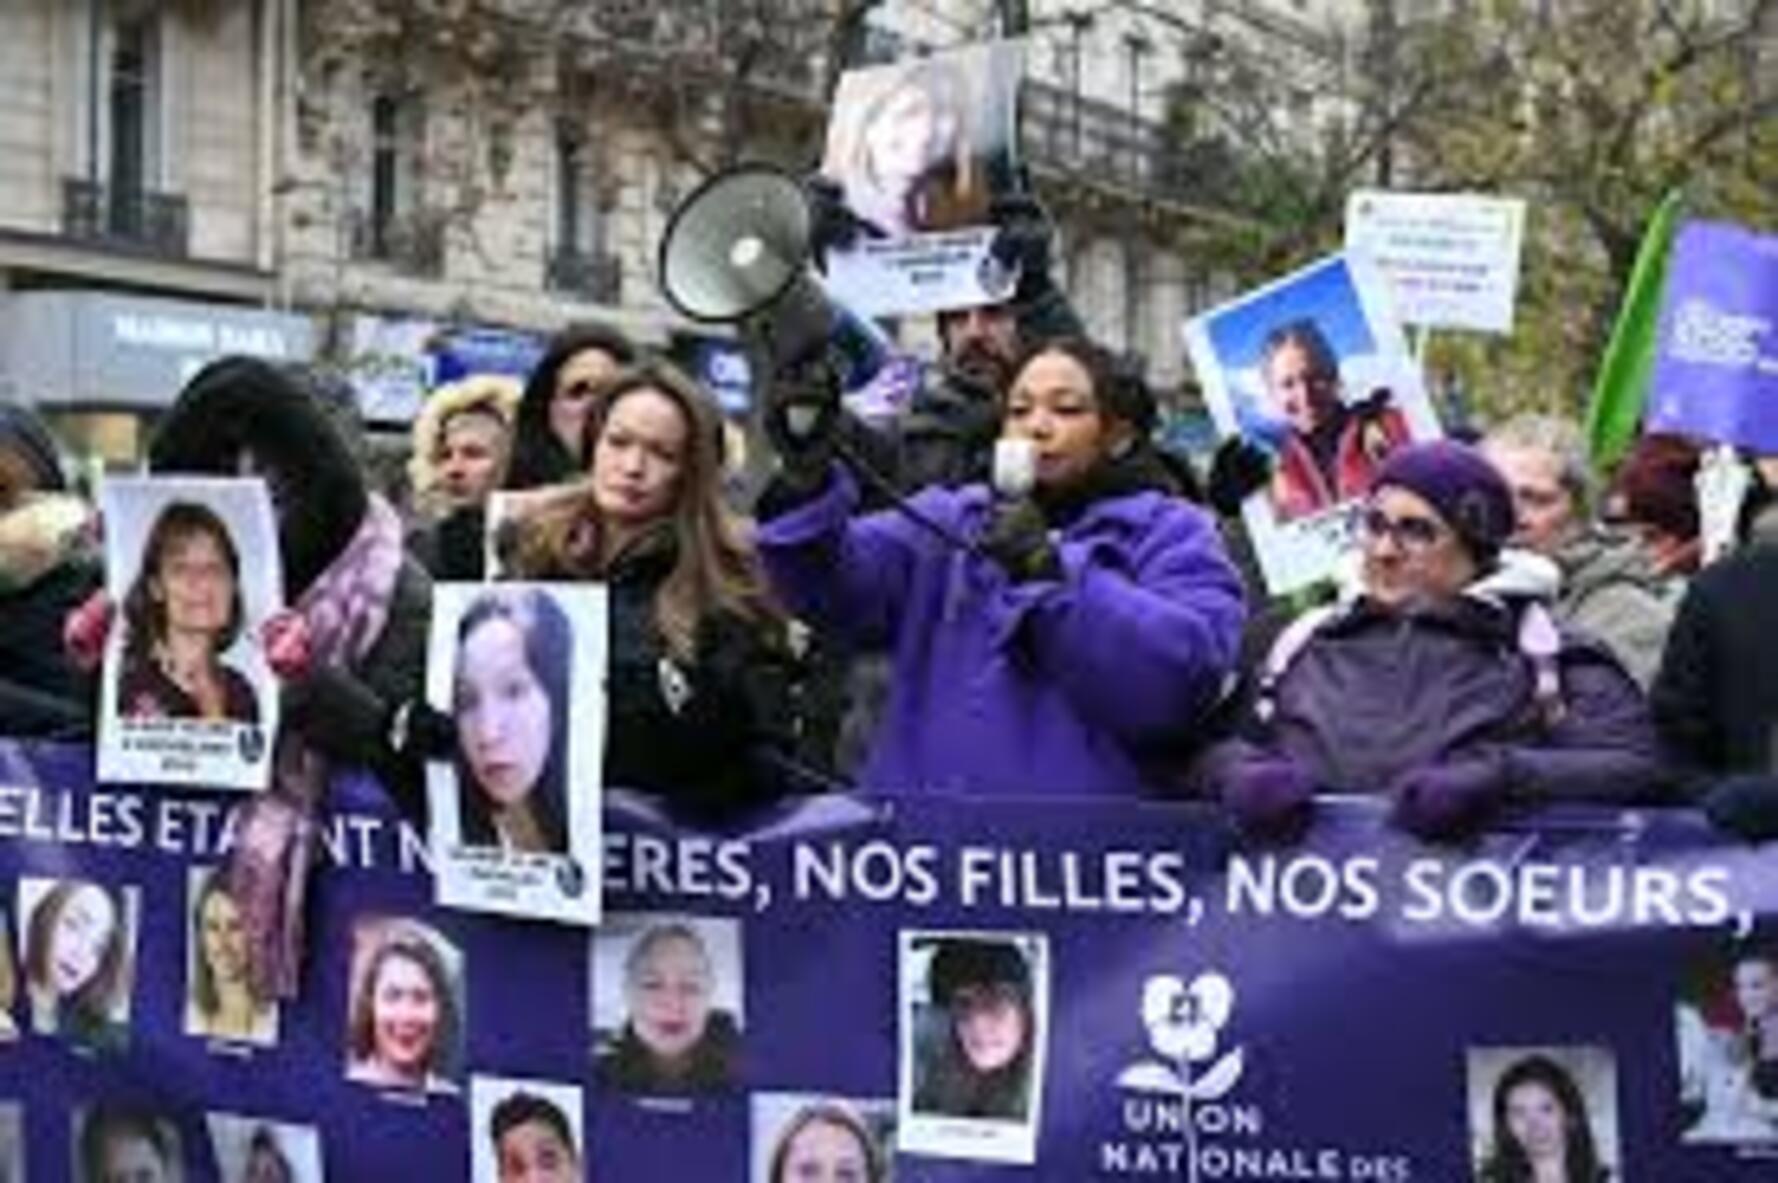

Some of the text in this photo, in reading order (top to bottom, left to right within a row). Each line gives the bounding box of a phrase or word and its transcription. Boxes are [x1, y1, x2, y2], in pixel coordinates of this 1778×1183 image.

[0, 787, 143, 847] ELLES
[601, 834, 1753, 936] ERES, NOS FILLES, NOS SOEURS,
